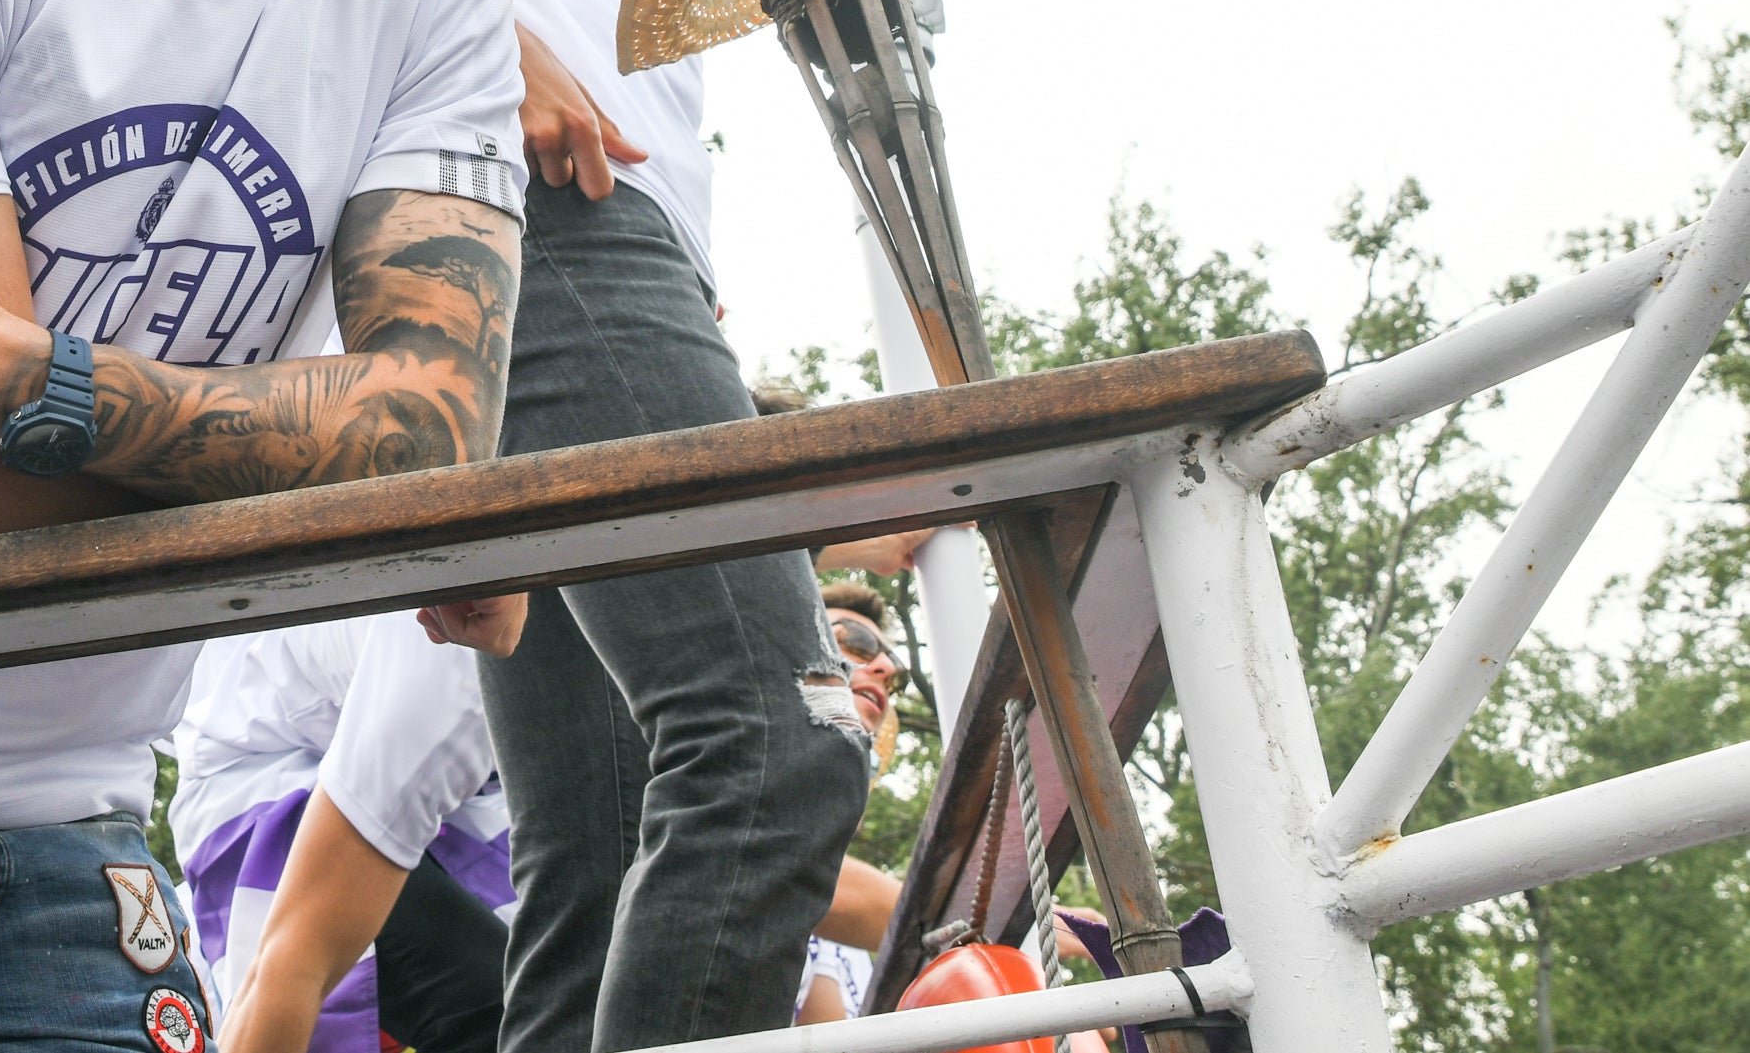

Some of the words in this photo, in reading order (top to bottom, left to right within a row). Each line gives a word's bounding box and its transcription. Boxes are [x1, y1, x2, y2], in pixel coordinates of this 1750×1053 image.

[13, 123, 146, 219] FICIÓN
[137, 937, 167, 951] VALTH
[147, 990, 164, 1023] MAKE
